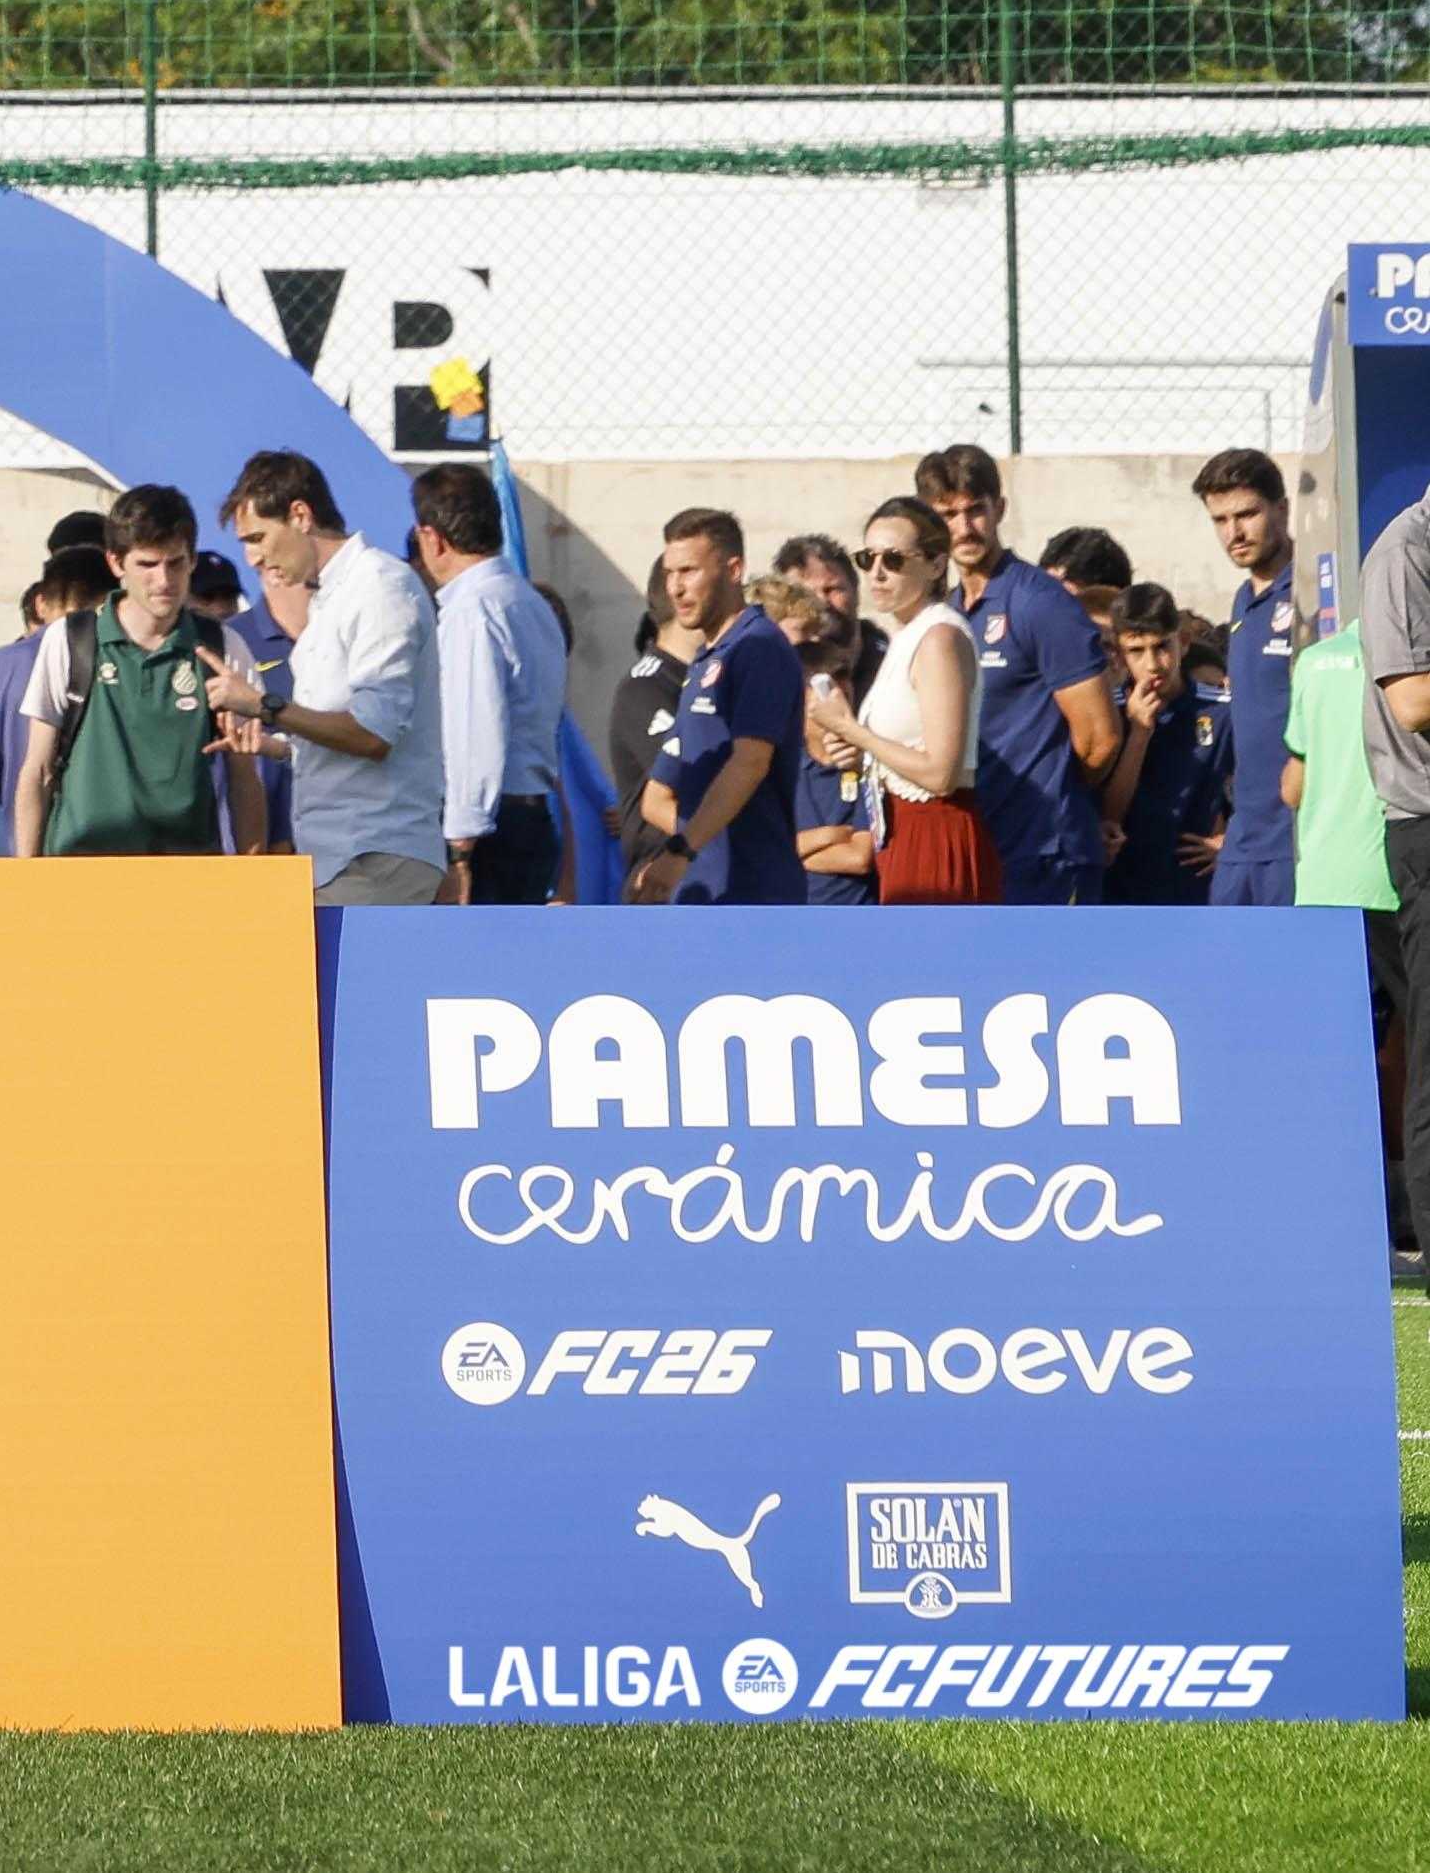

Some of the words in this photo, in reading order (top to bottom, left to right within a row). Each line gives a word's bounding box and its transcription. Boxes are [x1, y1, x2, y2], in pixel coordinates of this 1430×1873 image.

[426, 994, 1182, 1129] PAMESA
[458, 1144, 1164, 1245] cerámica
[457, 1342, 510, 1368] EA
[840, 1327, 1194, 1394] moeve
[456, 1369, 512, 1382] SPORTS
[872, 1542, 898, 1569] DE
[906, 1542, 987, 1569] CABRAS
[449, 1645, 702, 1707] LALIGA
[736, 1654, 784, 1680] EA
[734, 1681, 786, 1694] SPORTS
